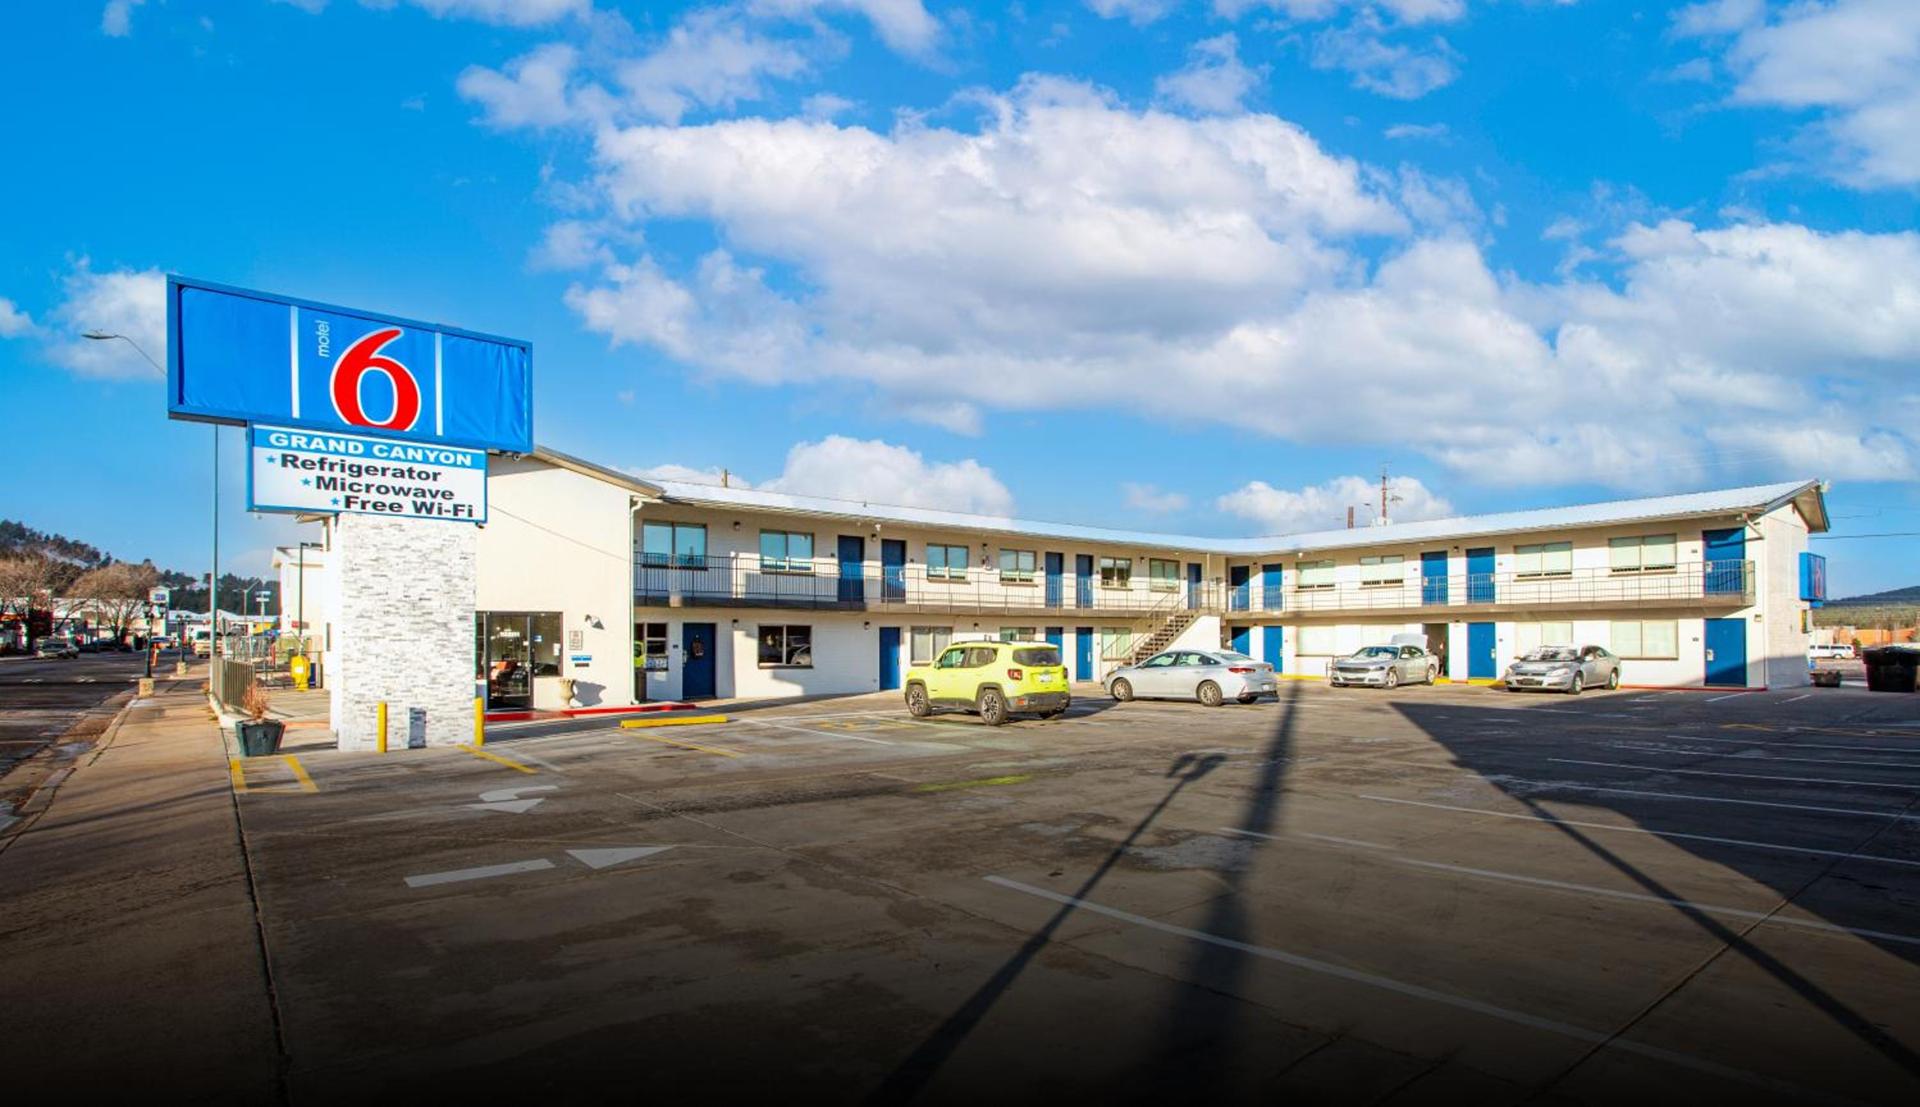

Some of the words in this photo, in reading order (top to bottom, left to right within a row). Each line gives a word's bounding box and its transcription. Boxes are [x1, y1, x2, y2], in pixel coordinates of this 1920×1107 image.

[315, 319, 330, 358] motel
[329, 326, 422, 432] 6
[269, 432, 365, 455] GRAND
[372, 444, 472, 467] CANYON
[281, 453, 442, 482] Refrigerator
[316, 475, 454, 501] Microwave
[344, 494, 404, 513] Free
[412, 500, 473, 518] Wi-Fi
